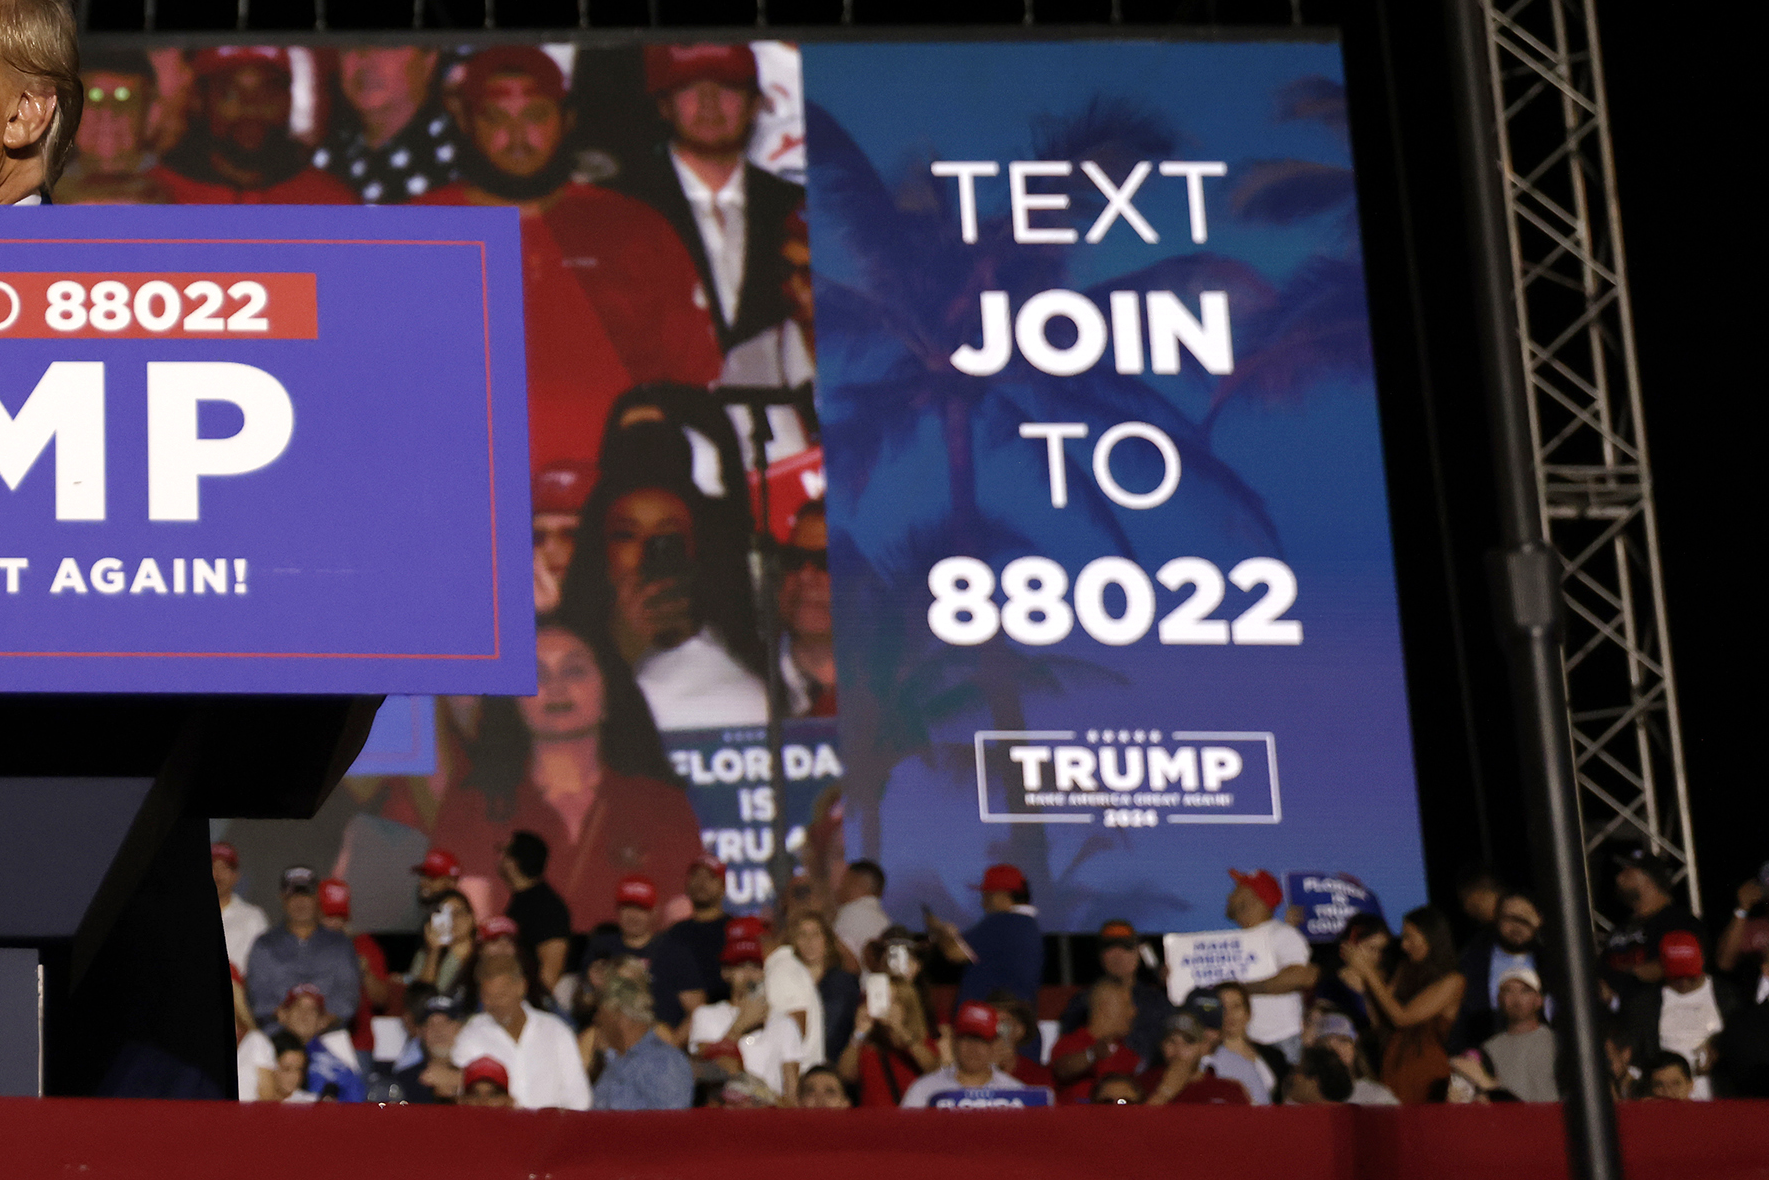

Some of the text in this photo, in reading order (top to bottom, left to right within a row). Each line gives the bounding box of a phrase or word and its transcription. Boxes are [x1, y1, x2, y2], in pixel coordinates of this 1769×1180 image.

[931, 161, 1228, 244] TEXT
[44, 280, 270, 332] 88022
[949, 288, 1234, 376] JOIN
[1018, 421, 1182, 510] TO
[49, 557, 248, 595] AGAIN!
[927, 555, 1304, 646] 88022
[1009, 746, 1243, 791] TRUMP
[737, 785, 776, 823] IS
